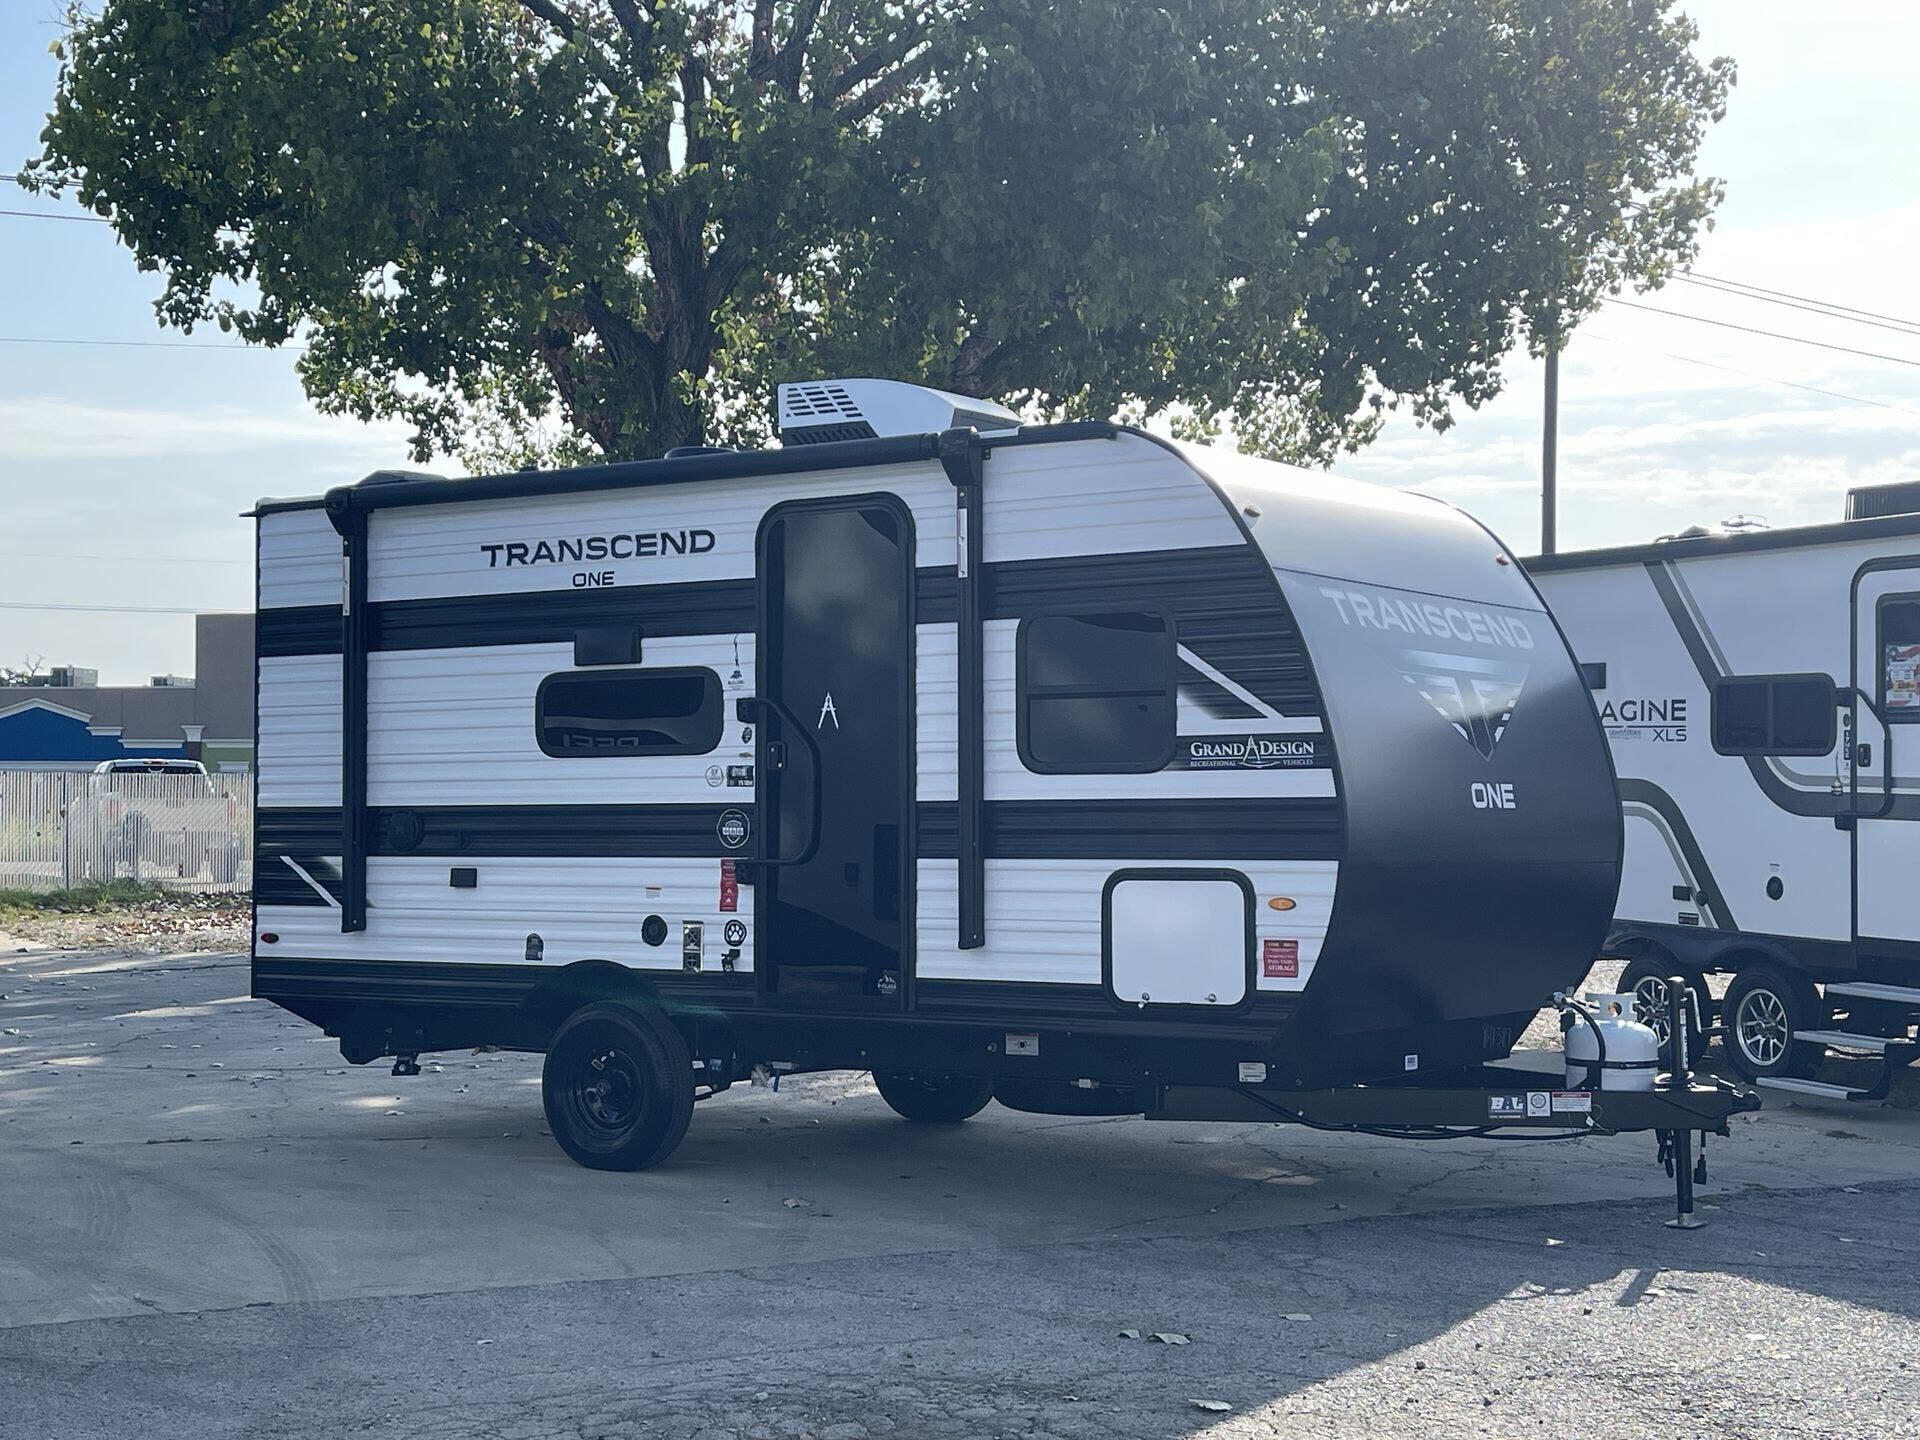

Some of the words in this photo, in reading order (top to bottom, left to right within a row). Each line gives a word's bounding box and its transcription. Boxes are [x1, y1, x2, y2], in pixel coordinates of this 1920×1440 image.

[480, 529, 716, 568] TRANSCEND
[572, 570, 615, 588] ONE
[1318, 586, 1535, 650] TRANSCEND
[1652, 728, 1687, 742] XLS
[1190, 742, 1244, 757] GRAND
[1259, 740, 1314, 755] DESIGN
[1190, 760, 1237, 768] RECREATIONAL
[1470, 782, 1517, 809] ONE
